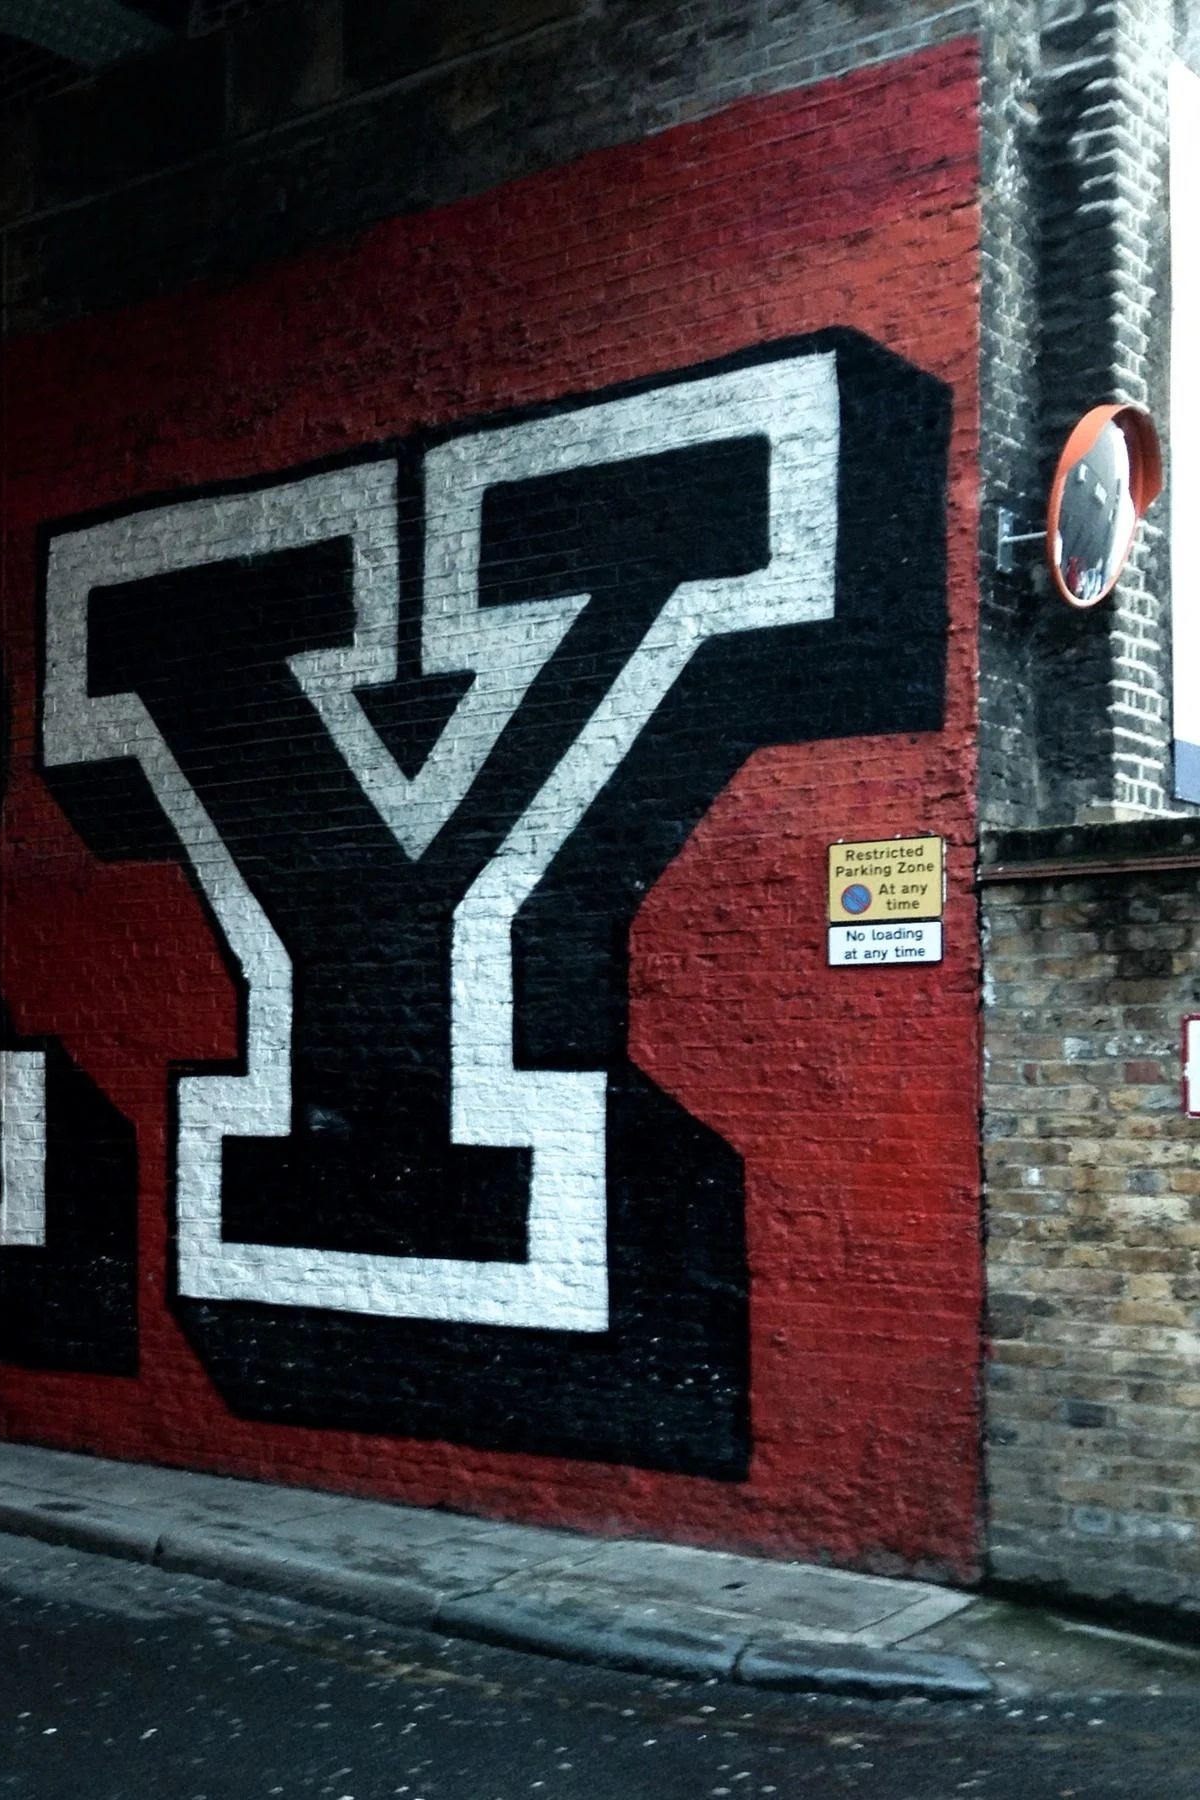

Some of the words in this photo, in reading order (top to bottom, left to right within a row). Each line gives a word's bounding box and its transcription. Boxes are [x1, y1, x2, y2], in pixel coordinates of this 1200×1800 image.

[845, 845, 924, 861] Restricted
[835, 865, 892, 877] Parking
[897, 862, 935, 874] Zone
[878, 884, 896, 895] At
[901, 884, 928, 895] any
[886, 899, 920, 910] time
[846, 930, 866, 941] No
[872, 928, 923, 941] loading
[844, 950, 857, 960] at
[864, 949, 888, 960] any
[895, 946, 926, 958] time
